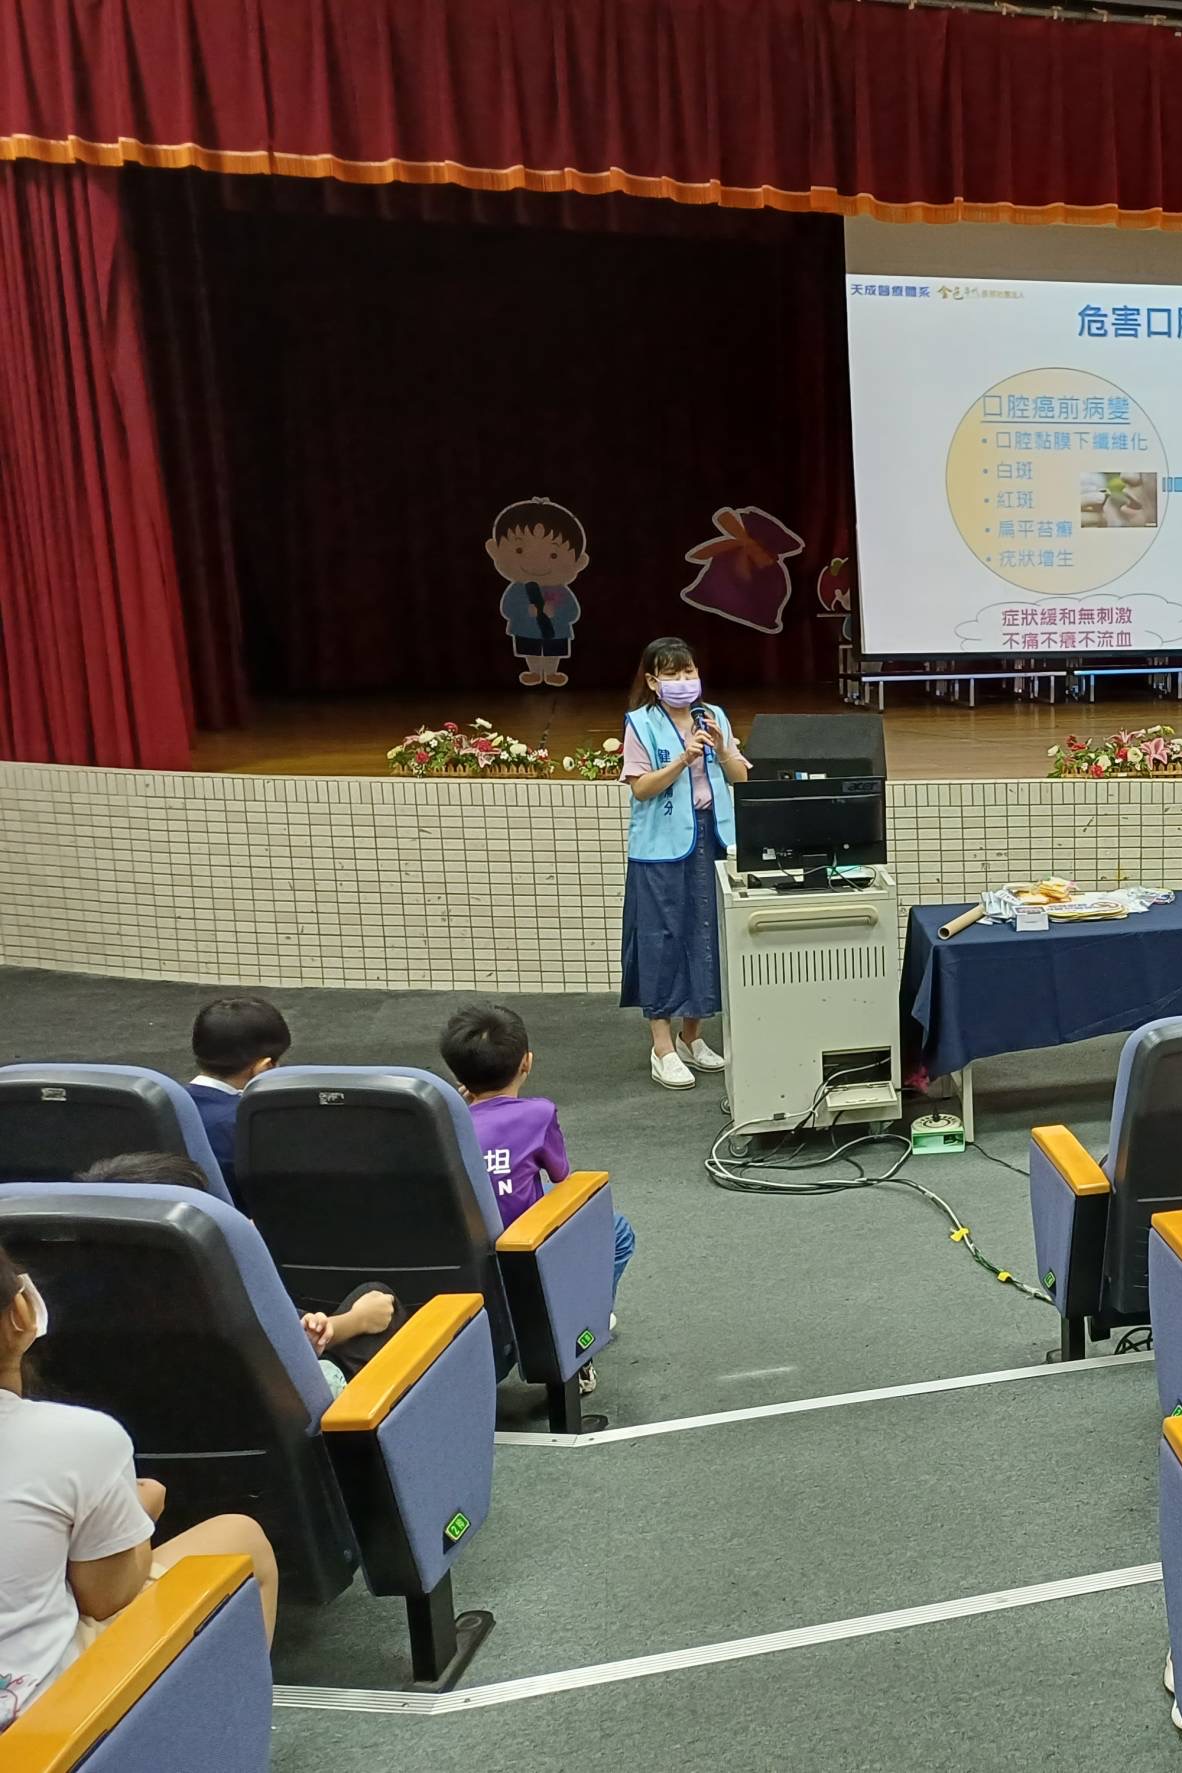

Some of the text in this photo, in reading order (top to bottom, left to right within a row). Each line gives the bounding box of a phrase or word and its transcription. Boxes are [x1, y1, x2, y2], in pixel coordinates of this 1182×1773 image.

[983, 394, 1130, 421] 口腔癌前病變
[997, 461, 1033, 480] 白斑
[997, 490, 1033, 509] 紅斑
[1002, 607, 1132, 627] 症狀緩和無刺激
[1002, 630, 1132, 650] 不痛不癢不流血
